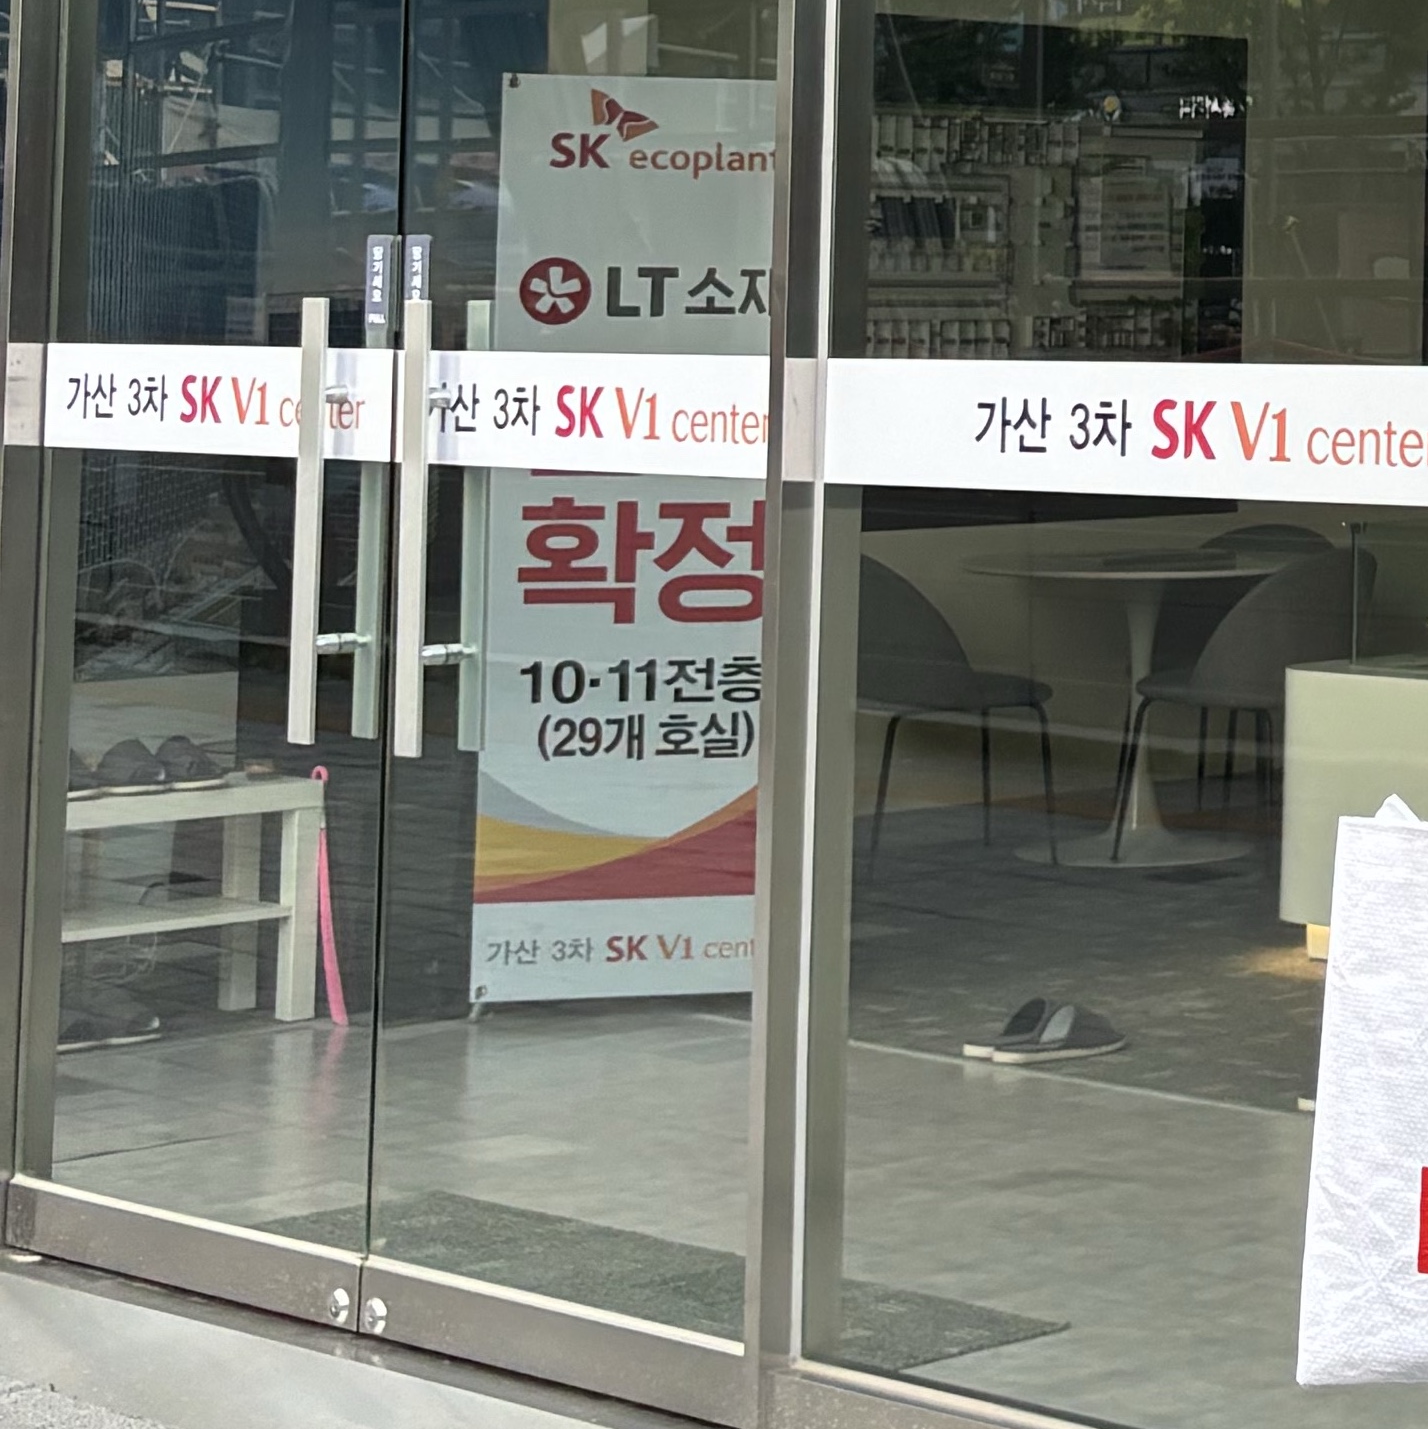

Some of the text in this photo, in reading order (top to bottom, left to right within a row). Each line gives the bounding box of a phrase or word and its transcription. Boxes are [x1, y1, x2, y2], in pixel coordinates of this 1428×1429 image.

[549, 132, 611, 169] SK
[66, 372, 366, 430] 가산 3차 SK V1 ceter
[493, 384, 541, 436] 3차
[554, 384, 605, 439] SK
[615, 387, 661, 441] V1
[974, 396, 1052, 454] 가산
[1069, 399, 1132, 457] 3차
[1151, 398, 1217, 460] SK
[1230, 401, 1292, 462] V1
[517, 495, 766, 625] 확정
[486, 938, 541, 966] 가산
[551, 936, 594, 963] 3차
[606, 934, 649, 962] SK
[656, 933, 695, 961] V1
